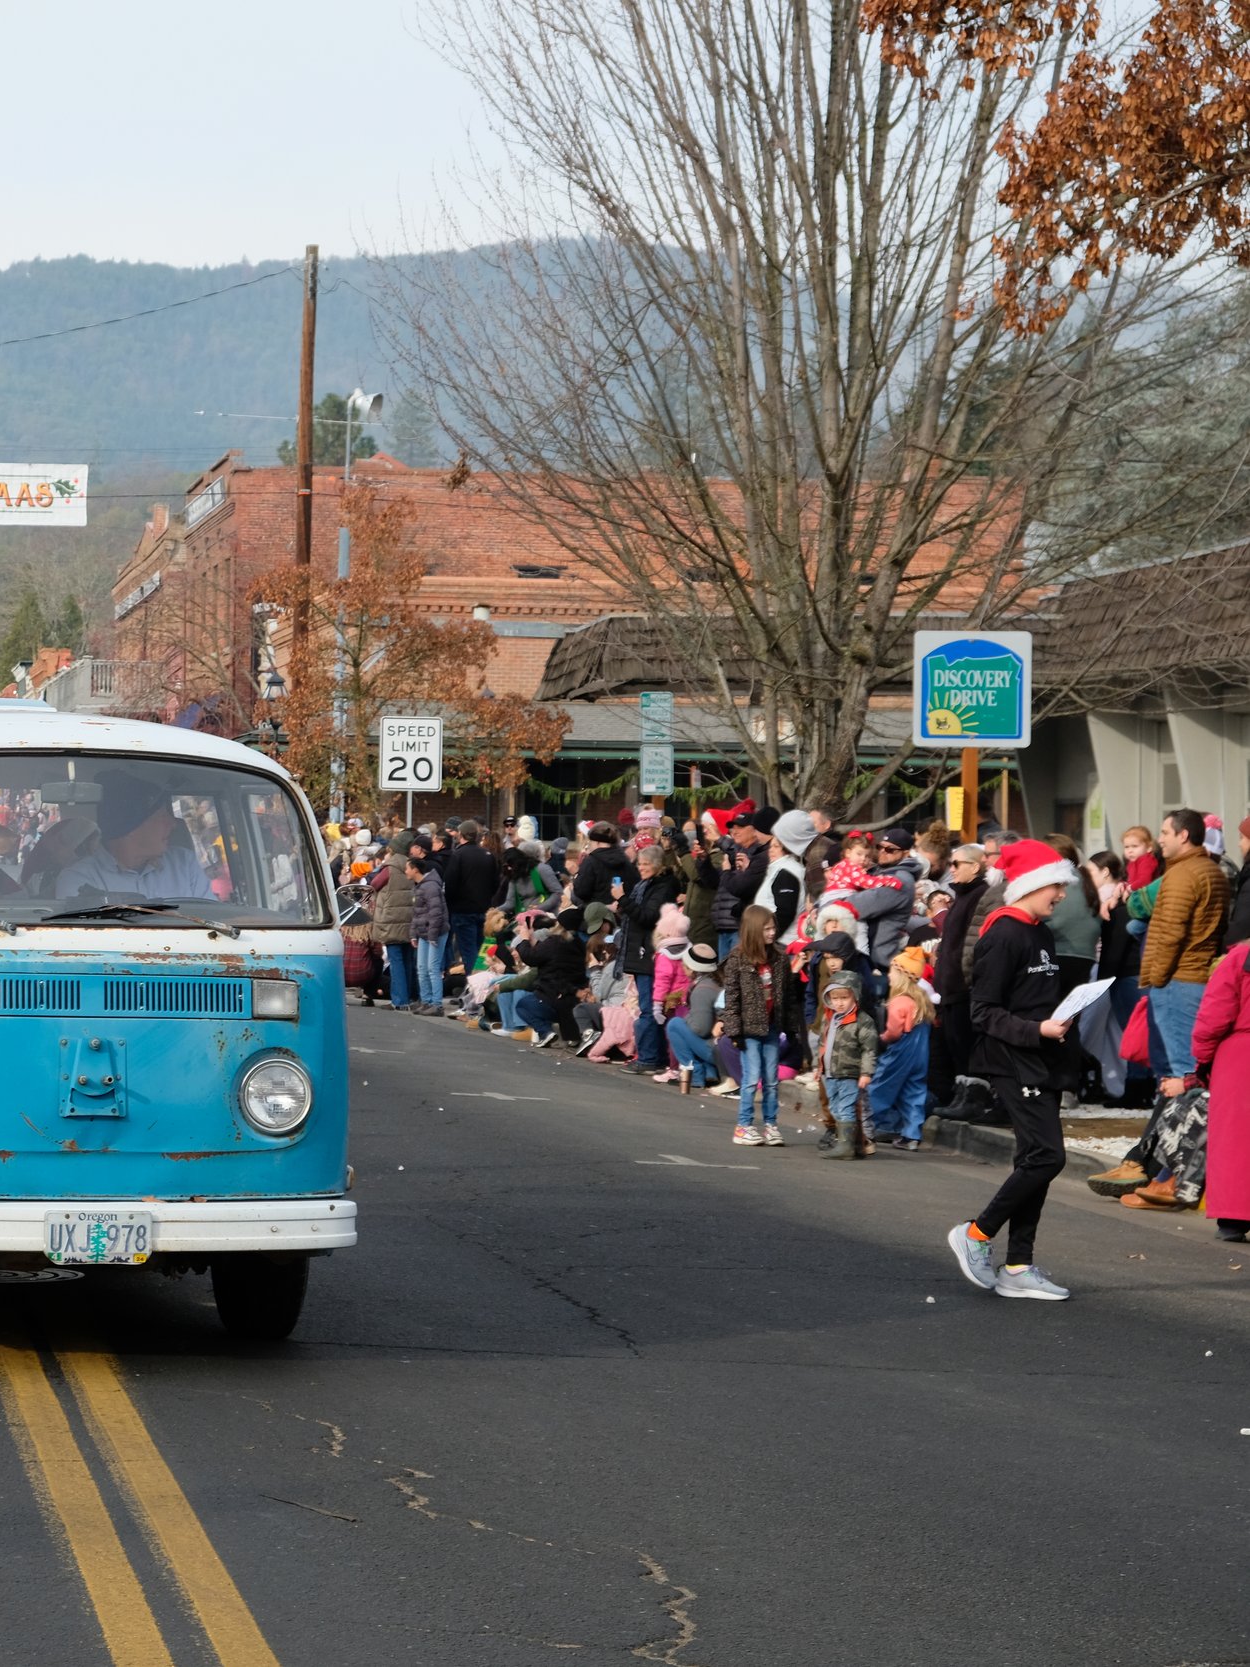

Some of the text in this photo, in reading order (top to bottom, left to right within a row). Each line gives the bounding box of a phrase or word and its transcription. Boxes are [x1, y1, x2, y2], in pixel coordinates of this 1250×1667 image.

[934, 670, 1013, 688] DISCOVERY
[950, 690, 998, 707] DRIVE
[387, 725, 436, 737] SPEED
[392, 741, 430, 752] LIMIT
[387, 756, 433, 782] 20
[78, 1212, 118, 1223] Oregon
[107, 1224, 147, 1252] 978
